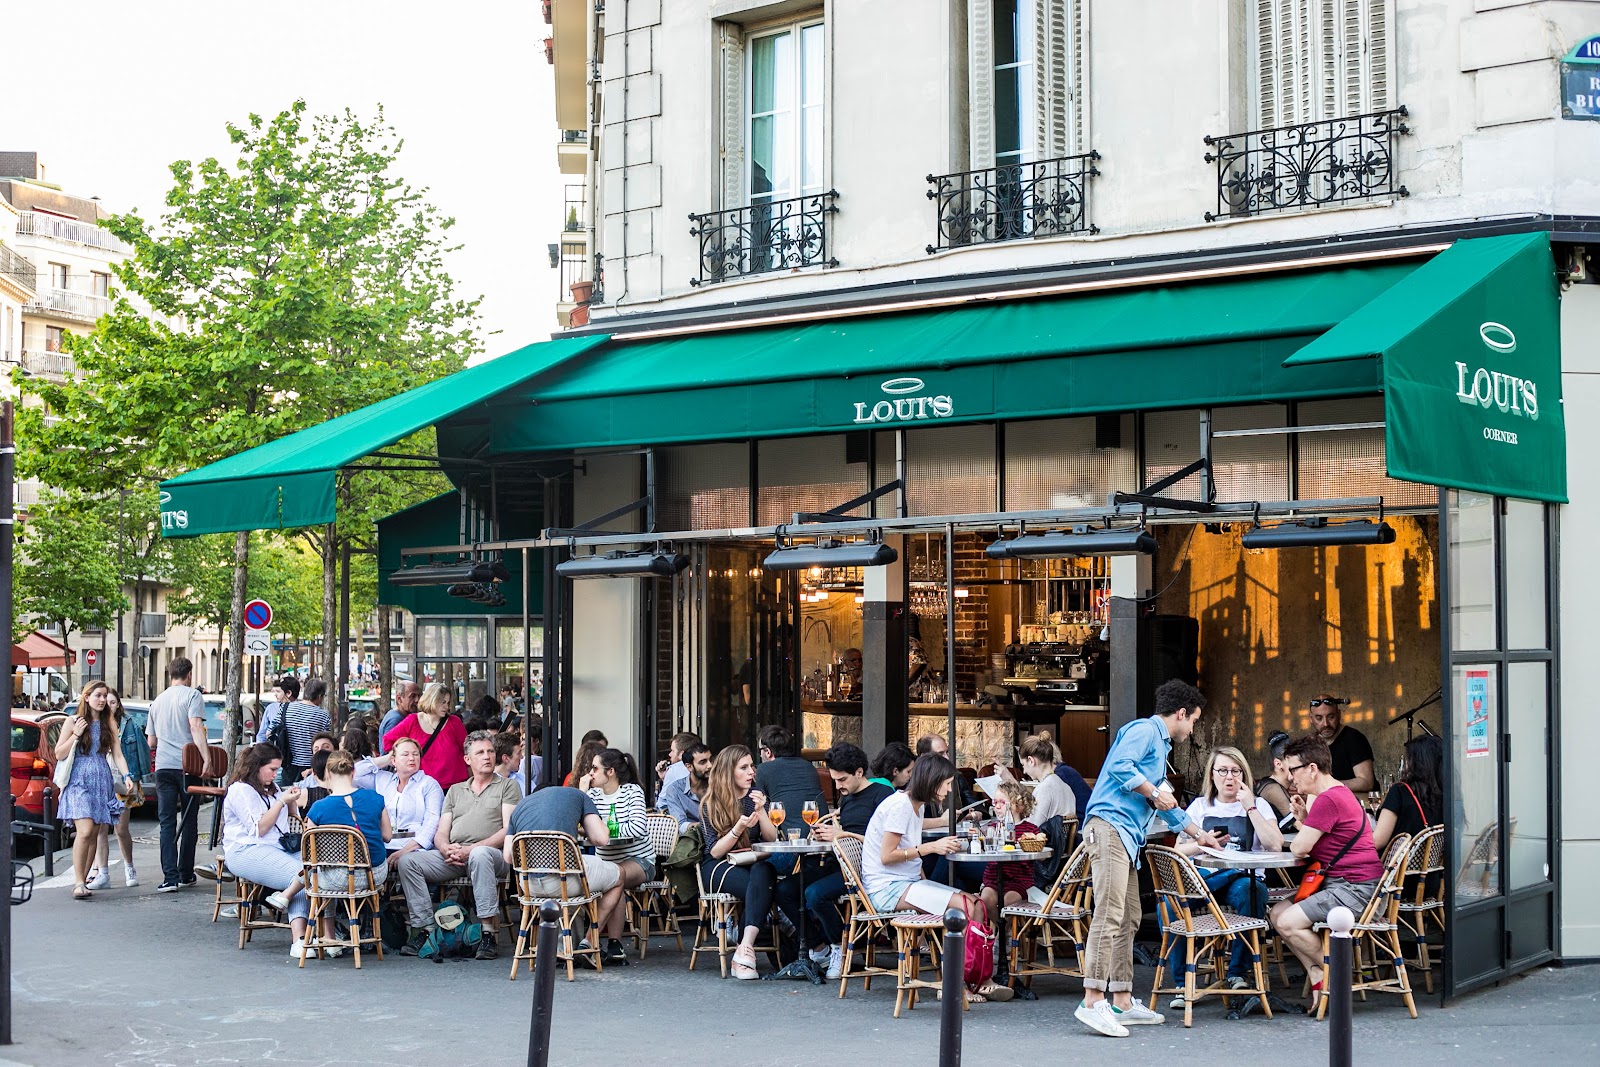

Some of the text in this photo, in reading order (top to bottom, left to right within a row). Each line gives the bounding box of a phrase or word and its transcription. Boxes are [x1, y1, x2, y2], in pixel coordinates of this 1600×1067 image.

[1455, 361, 1539, 421] LOUI'S
[853, 395, 954, 424] LOUI'S
[1483, 427, 1518, 445] CORNER
